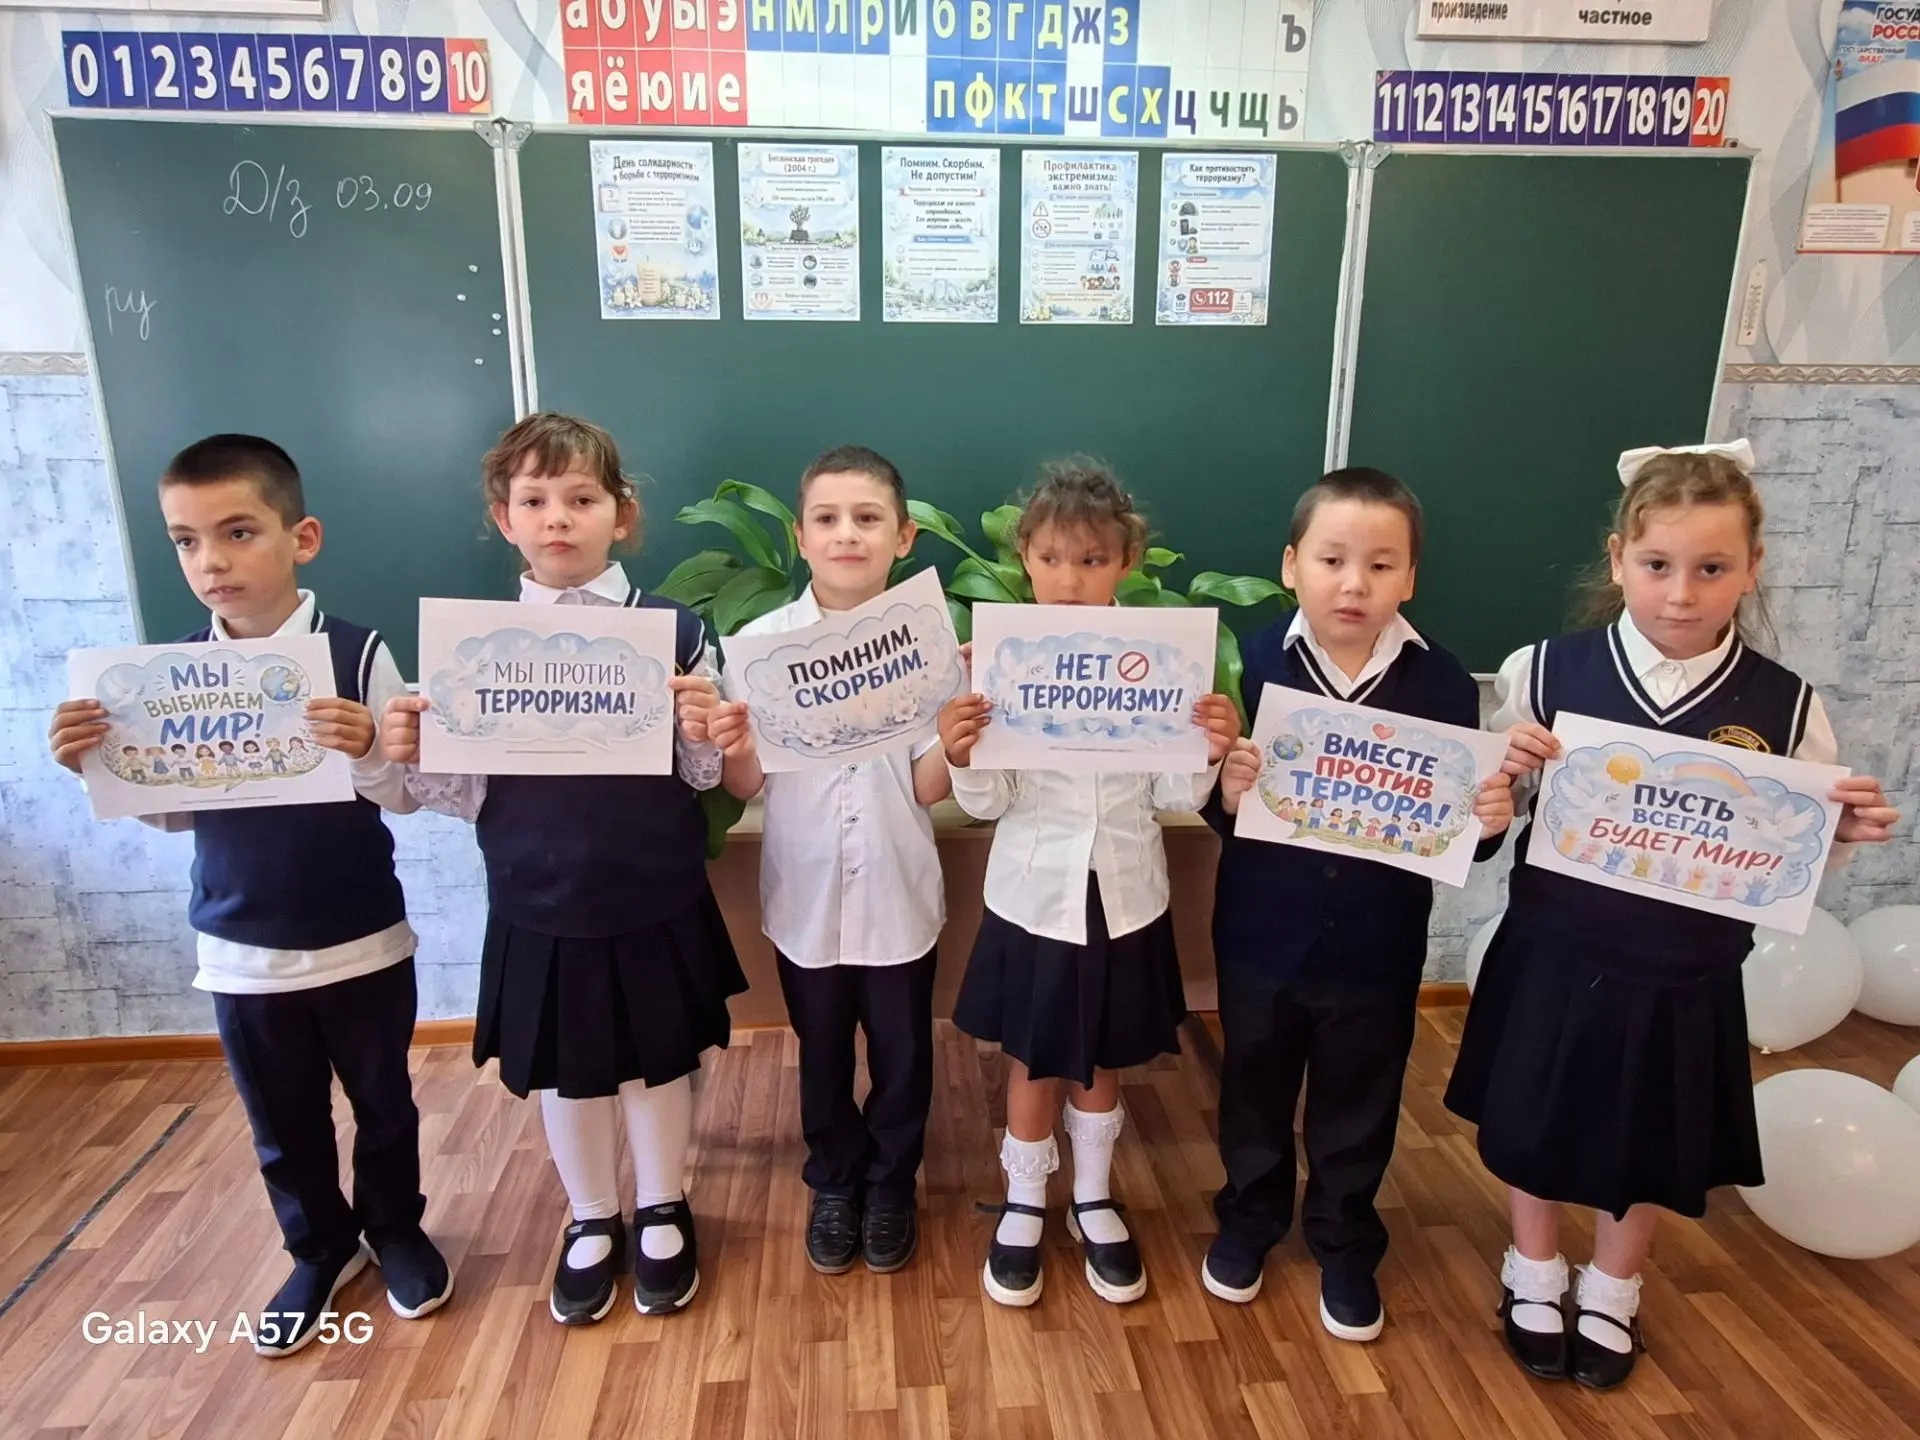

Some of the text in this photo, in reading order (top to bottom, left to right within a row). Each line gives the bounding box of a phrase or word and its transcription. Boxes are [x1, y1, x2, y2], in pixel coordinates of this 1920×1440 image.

[1431, 0, 1508, 23] произведение
[1578, 8, 1652, 25] частное
[1872, 24, 1920, 40] РОСС
[71, 44, 487, 102] 0 1 2 3 4 5 6 7 8 9 10
[1378, 83, 1725, 137] 11 12 13 14 15 16 17 18 19 20
[613, 156, 693, 171] День солидарности
[619, 169, 645, 181] борьбе
[653, 171, 700, 182] терроризмом
[784, 164, 806, 173] (2004
[900, 157, 985, 171] Помним. Скорбим.
[911, 170, 977, 183] Не допустим!
[1043, 160, 1117, 172] Профилактика
[1048, 173, 1117, 182] экстремизма:
[1189, 164, 1203, 172] Как
[1196, 173, 1246, 184] терроризму?
[336, 175, 432, 211] 03.09
[1207, 291, 1229, 305] 112
[787, 623, 919, 685] ПОМНИМ.
[1055, 653, 1113, 681] НЕТ
[170, 662, 229, 691] МЫ
[494, 661, 626, 686] МЫ ПРОТИВ
[795, 648, 928, 708] СКОРБИМ.
[143, 691, 263, 719] ВЫБИРАЕМ
[475, 688, 636, 716] ТЕРРОРИЗМА!
[1018, 683, 1184, 713] ТЕРРОРИЗМУ!
[160, 711, 264, 746] МИР!
[1324, 732, 1439, 777] ВМЕСТЕ
[1315, 756, 1433, 799] ПРОТИВ
[1289, 769, 1452, 828] ТЕРРОРА!
[1633, 783, 1735, 822] ПУСТЬ
[1632, 807, 1729, 842] ВСЕГДА
[1589, 817, 1784, 876] БУДЕТ МИР!
